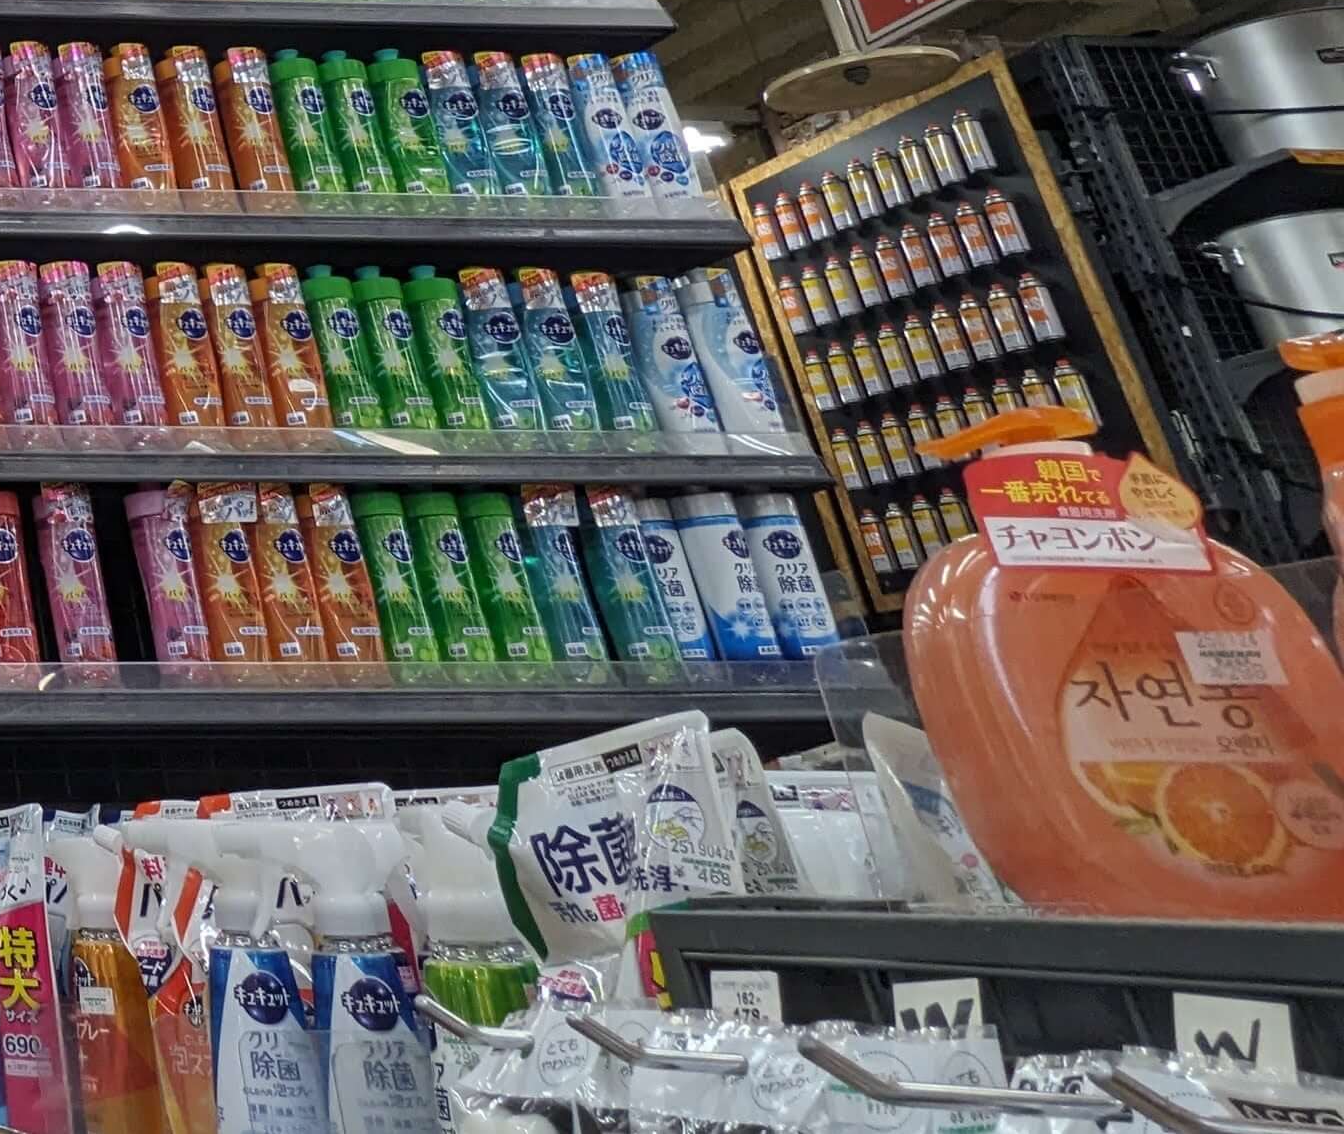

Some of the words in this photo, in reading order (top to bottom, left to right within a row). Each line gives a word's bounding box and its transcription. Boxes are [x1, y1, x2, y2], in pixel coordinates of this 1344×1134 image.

[1034, 458, 1103, 483] 韓国で
[981, 480, 1111, 505] 一番売れてる
[996, 523, 1157, 553] チャヨンポン
[775, 563, 809, 575] クリア
[779, 575, 816, 595] 除菌
[530, 811, 638, 898] 除菌
[234, 985, 291, 1006] キュキュット
[342, 992, 401, 1015] キュキュット
[6, 1010, 39, 1024] サイズ
[2, 1034, 42, 1057] 690
[1195, 1018, 1261, 1068] W
[251, 1050, 302, 1083] 除菌
[363, 1060, 417, 1092] 除菌
